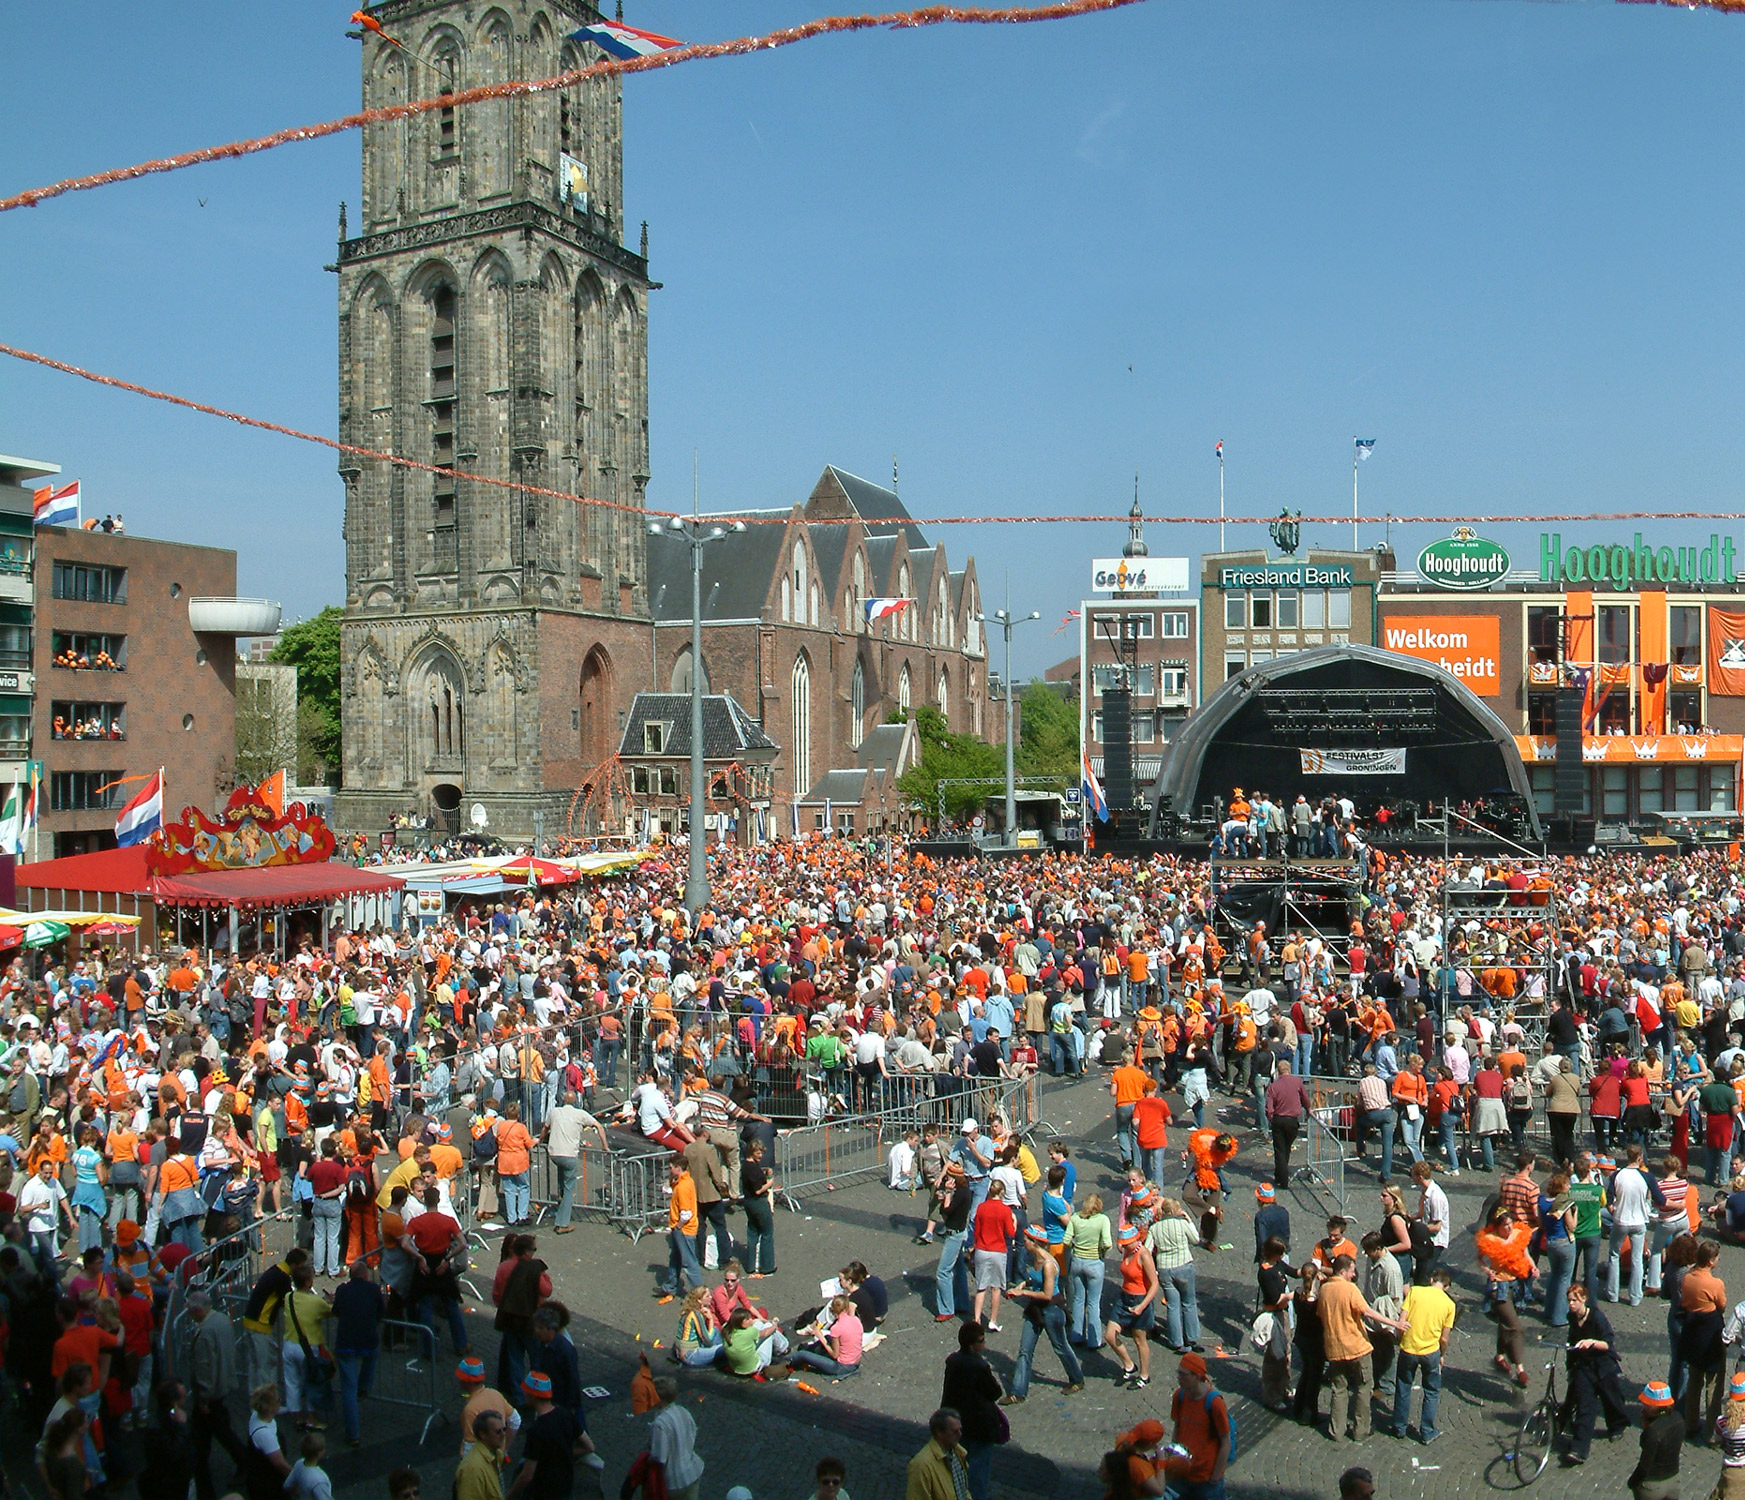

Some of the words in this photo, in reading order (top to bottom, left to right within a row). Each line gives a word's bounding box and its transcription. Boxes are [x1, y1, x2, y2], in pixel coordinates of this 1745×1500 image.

[1425, 552, 1504, 577] Hooghoudt
[1539, 532, 1737, 592] Hooghoudt
[1221, 567, 1303, 586] Friesland
[1305, 567, 1351, 585] Bank
[1386, 628, 1468, 649] Welkom
